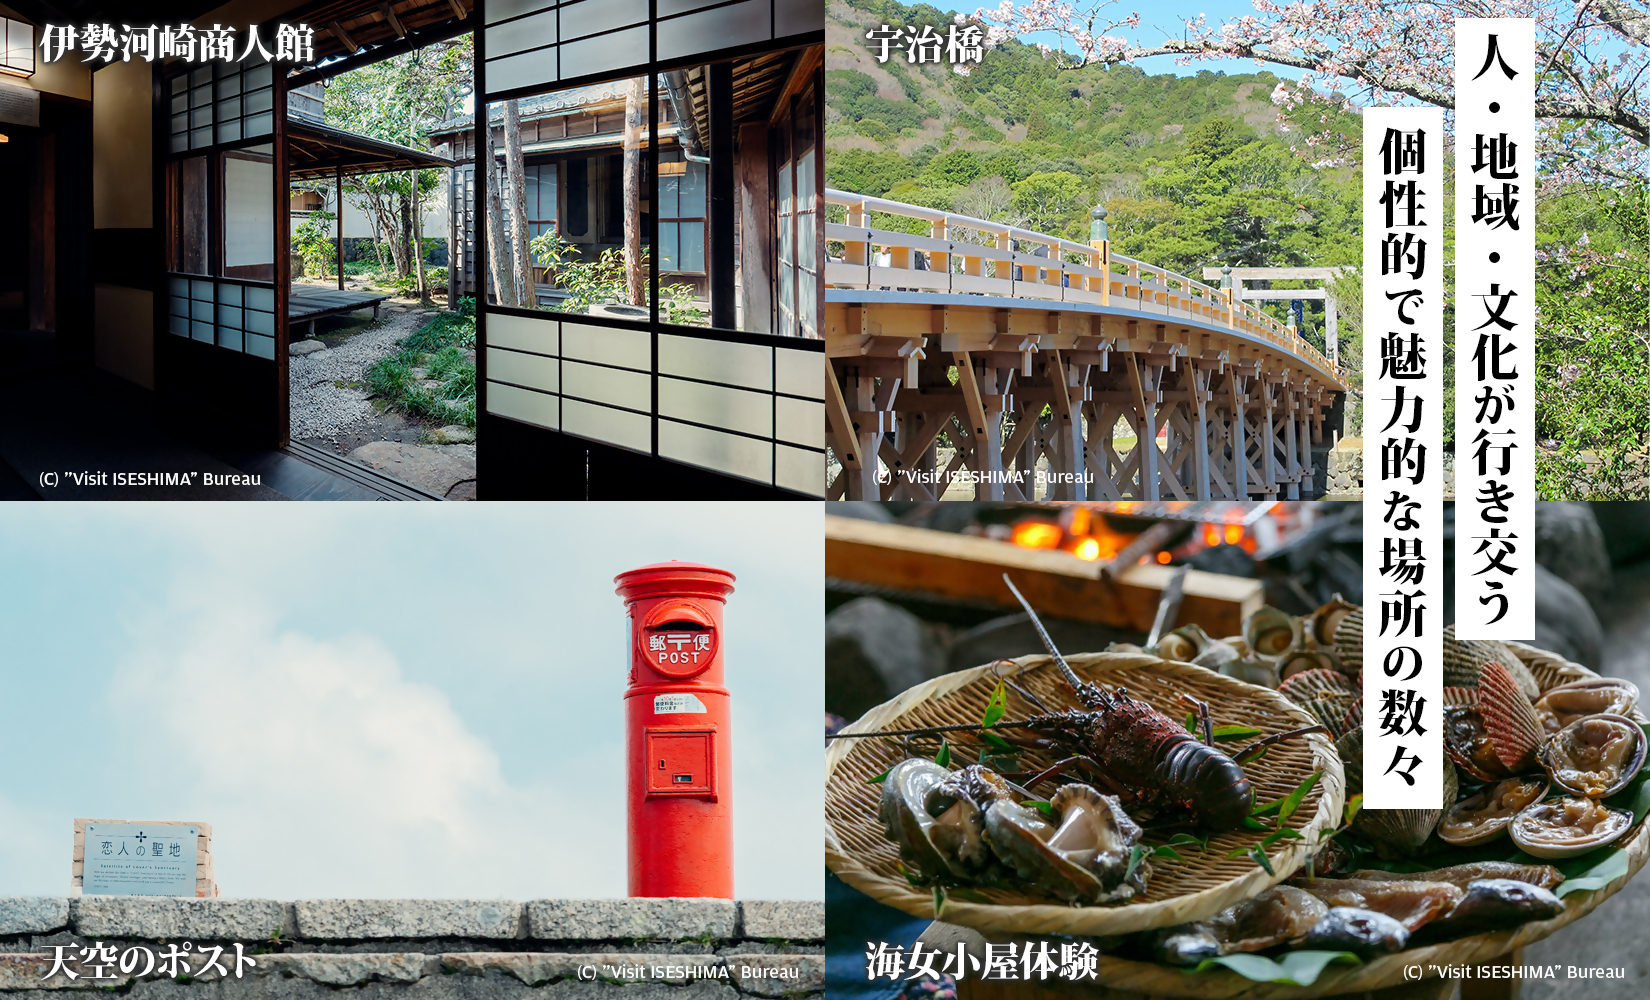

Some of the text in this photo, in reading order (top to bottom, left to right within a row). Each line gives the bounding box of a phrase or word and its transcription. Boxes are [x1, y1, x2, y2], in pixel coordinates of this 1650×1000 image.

[658, 652, 700, 664] POST
[101, 841, 180, 857] 恋人の聖地
